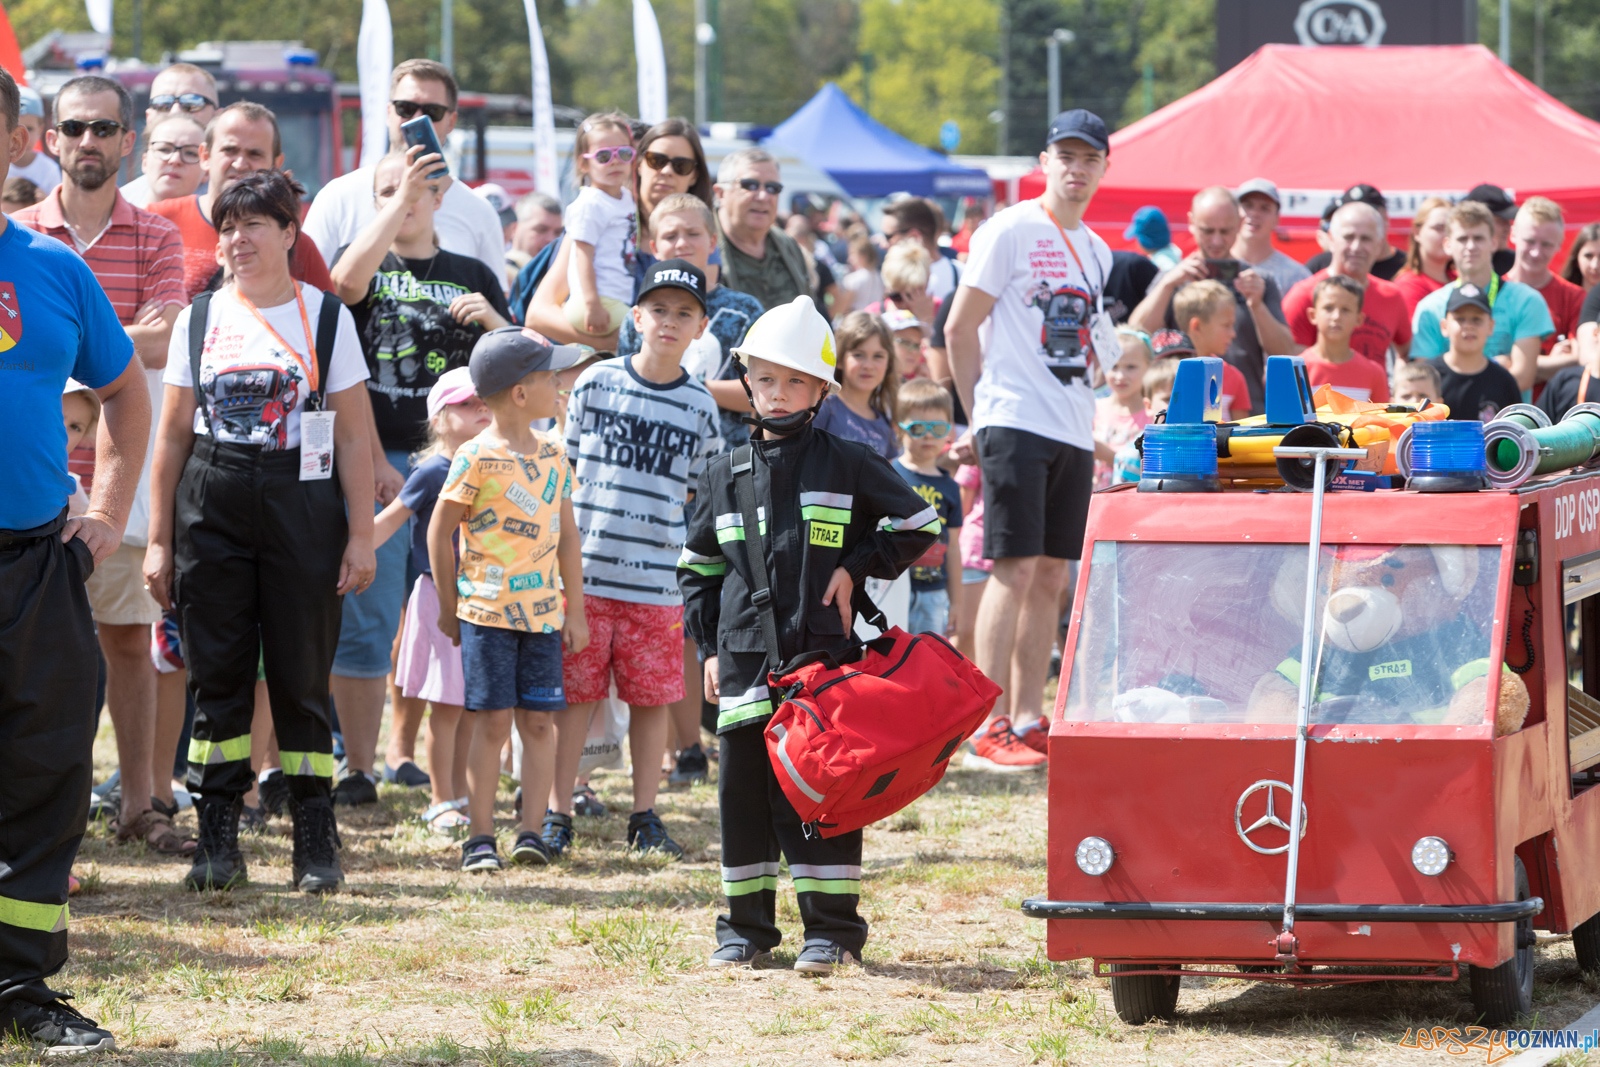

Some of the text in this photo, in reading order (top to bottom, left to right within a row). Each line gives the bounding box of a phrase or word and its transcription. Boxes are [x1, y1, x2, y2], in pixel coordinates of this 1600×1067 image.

[592, 411, 698, 457] IPSWICH
[604, 440, 674, 477] TOWN
[1555, 488, 1600, 540] DDP OSP
